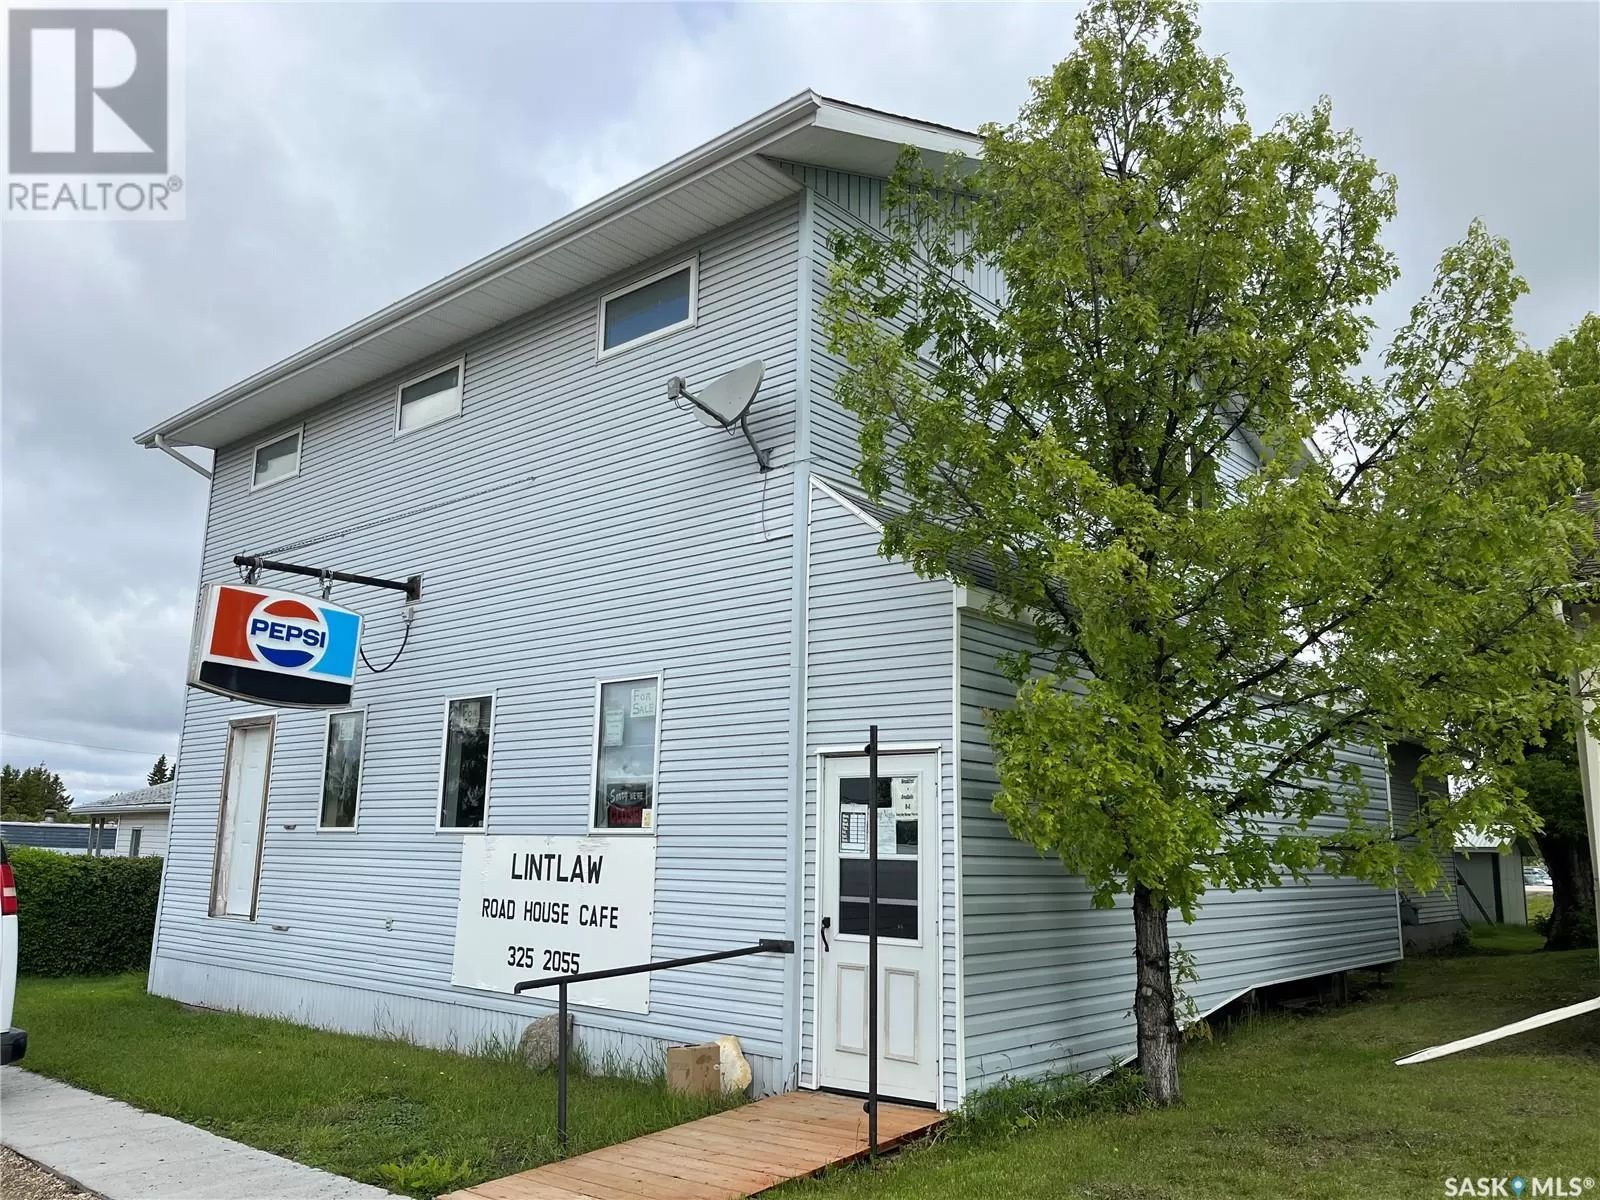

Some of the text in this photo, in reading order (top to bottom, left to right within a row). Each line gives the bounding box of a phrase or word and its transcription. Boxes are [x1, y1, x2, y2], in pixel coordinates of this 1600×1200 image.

[250, 618, 327, 649] PEPSI
[632, 702, 654, 715] SALE
[511, 853, 603, 884] LINTLAW
[481, 898, 619, 929] ROAD HOUSE CAFE
[507, 945, 581, 975] 325 2055
